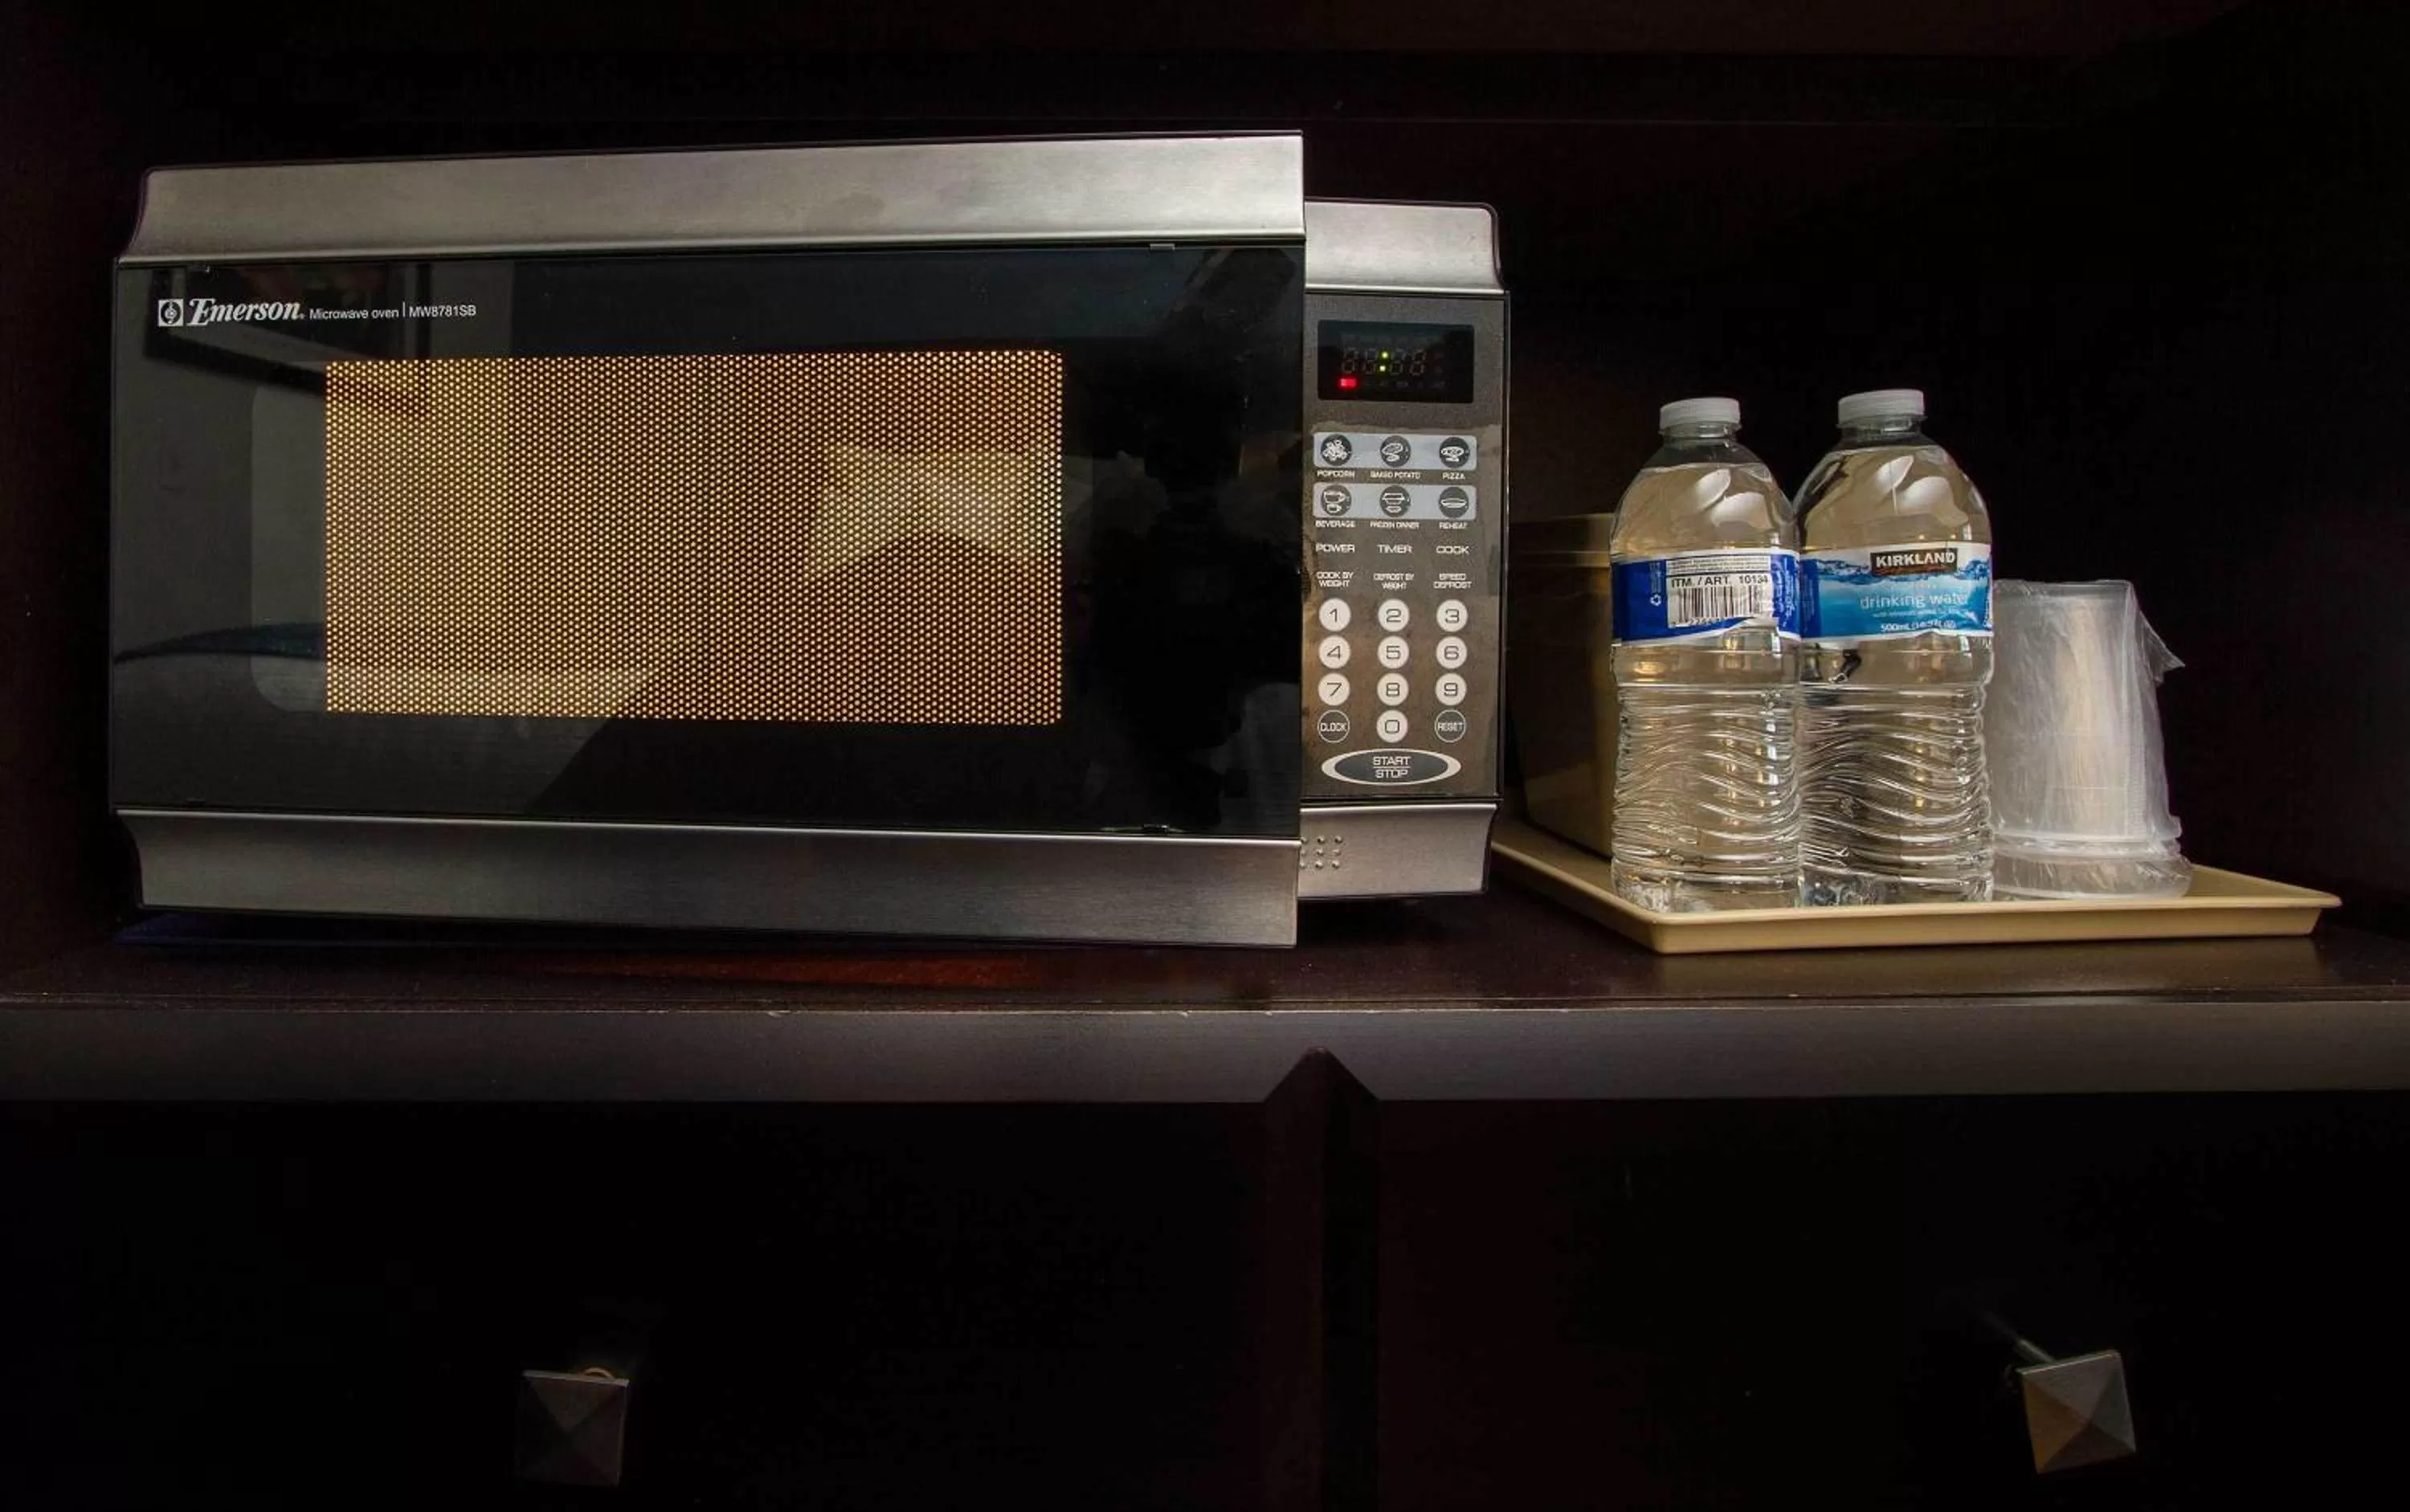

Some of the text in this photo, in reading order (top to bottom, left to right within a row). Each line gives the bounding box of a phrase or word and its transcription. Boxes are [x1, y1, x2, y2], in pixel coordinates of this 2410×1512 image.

[187, 298, 300, 326] Emerson
[309, 308, 399, 320] Microwave oven
[409, 304, 476, 317] MW8781SB
[1317, 470, 1355, 478] POPCORN
[1442, 472, 1465, 480] PIZZA
[1315, 520, 1356, 528] BEVERAGE
[1315, 544, 1355, 553] POWER
[1377, 545, 1412, 554] TIMER
[1436, 546, 1469, 554] COOK
[1876, 551, 1955, 568] KIRKLAND
[1317, 571, 1354, 579] COOK BY
[1318, 579, 1350, 587] WEIGHT
[1860, 594, 1926, 610] drinking
[1329, 608, 1338, 623] 1
[1386, 608, 1402, 623] 2
[1444, 609, 1460, 623] 3
[1326, 645, 1342, 660] 4
[1386, 645, 1401, 660] 5
[1444, 645, 1459, 660] 6
[1326, 682, 1342, 697] 7
[1386, 682, 1400, 697] 8
[1444, 683, 1458, 697] 9
[1320, 722, 1347, 732] CLOCK
[1384, 719, 1400, 734] 0
[1438, 722, 1464, 732] RESET
[1373, 756, 1411, 766] START
[1375, 769, 1407, 778] STOP
